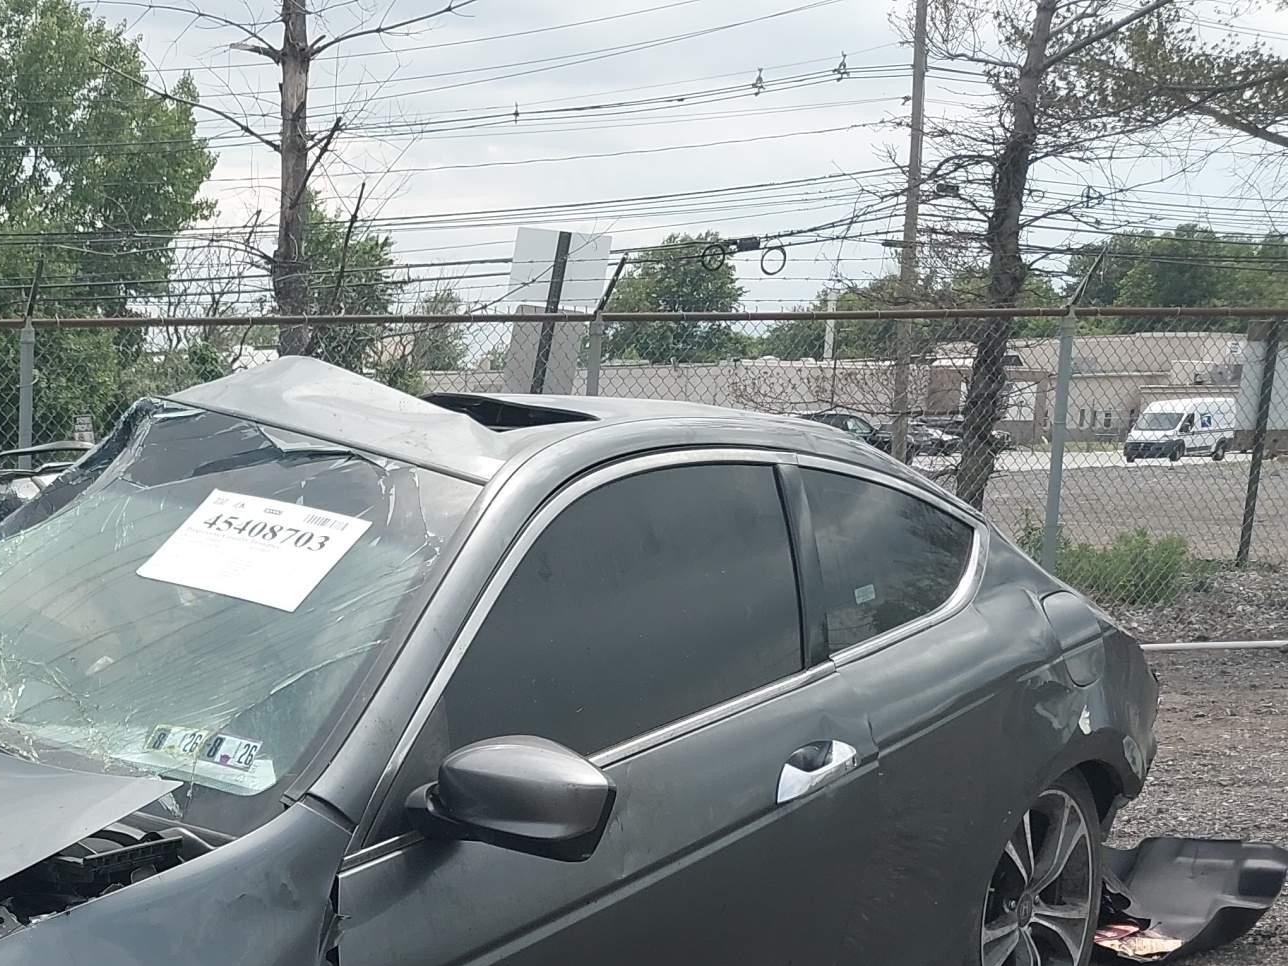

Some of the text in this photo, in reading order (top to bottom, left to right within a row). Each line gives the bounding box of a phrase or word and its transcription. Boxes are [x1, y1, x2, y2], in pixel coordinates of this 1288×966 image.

[202, 513, 331, 552] 45408703
[207, 736, 258, 766] 8 26
